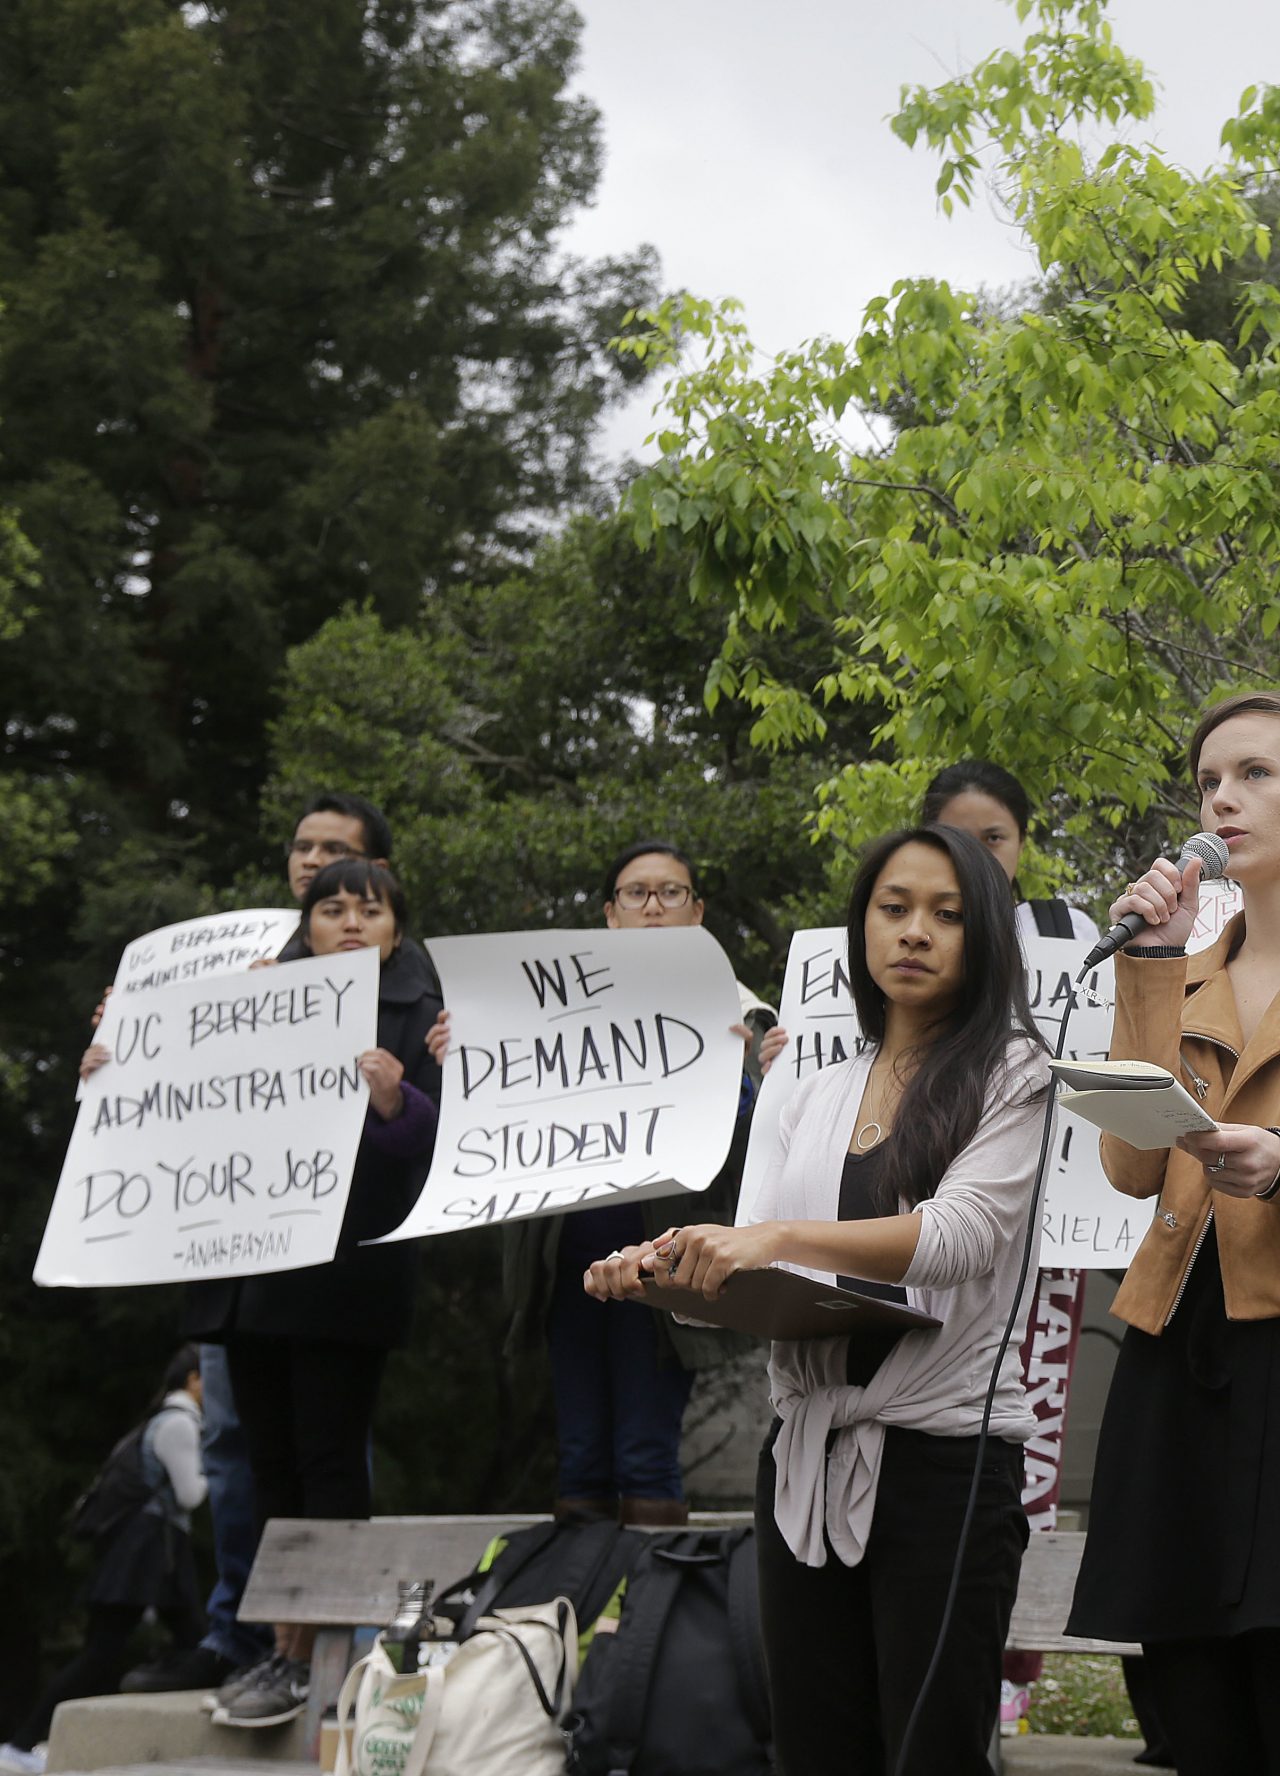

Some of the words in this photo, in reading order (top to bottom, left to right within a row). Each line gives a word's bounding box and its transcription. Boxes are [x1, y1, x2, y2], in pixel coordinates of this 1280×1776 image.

[129, 945, 156, 971] UC
[171, 920, 279, 952] BERKELEY
[522, 951, 614, 1008] WE
[116, 1013, 162, 1065] UC
[189, 977, 354, 1049] BERKELEY
[1081, 986, 1098, 1000] XLR
[448, 1013, 704, 1099] DEMAND
[89, 1057, 360, 1137] ADMINISTRATION
[454, 1105, 675, 1177] STUDENT
[76, 1169, 151, 1223] DO
[157, 1151, 254, 1212] YOUR
[267, 1149, 337, 1200] JOB
[1042, 1213, 1135, 1252] RIELA
